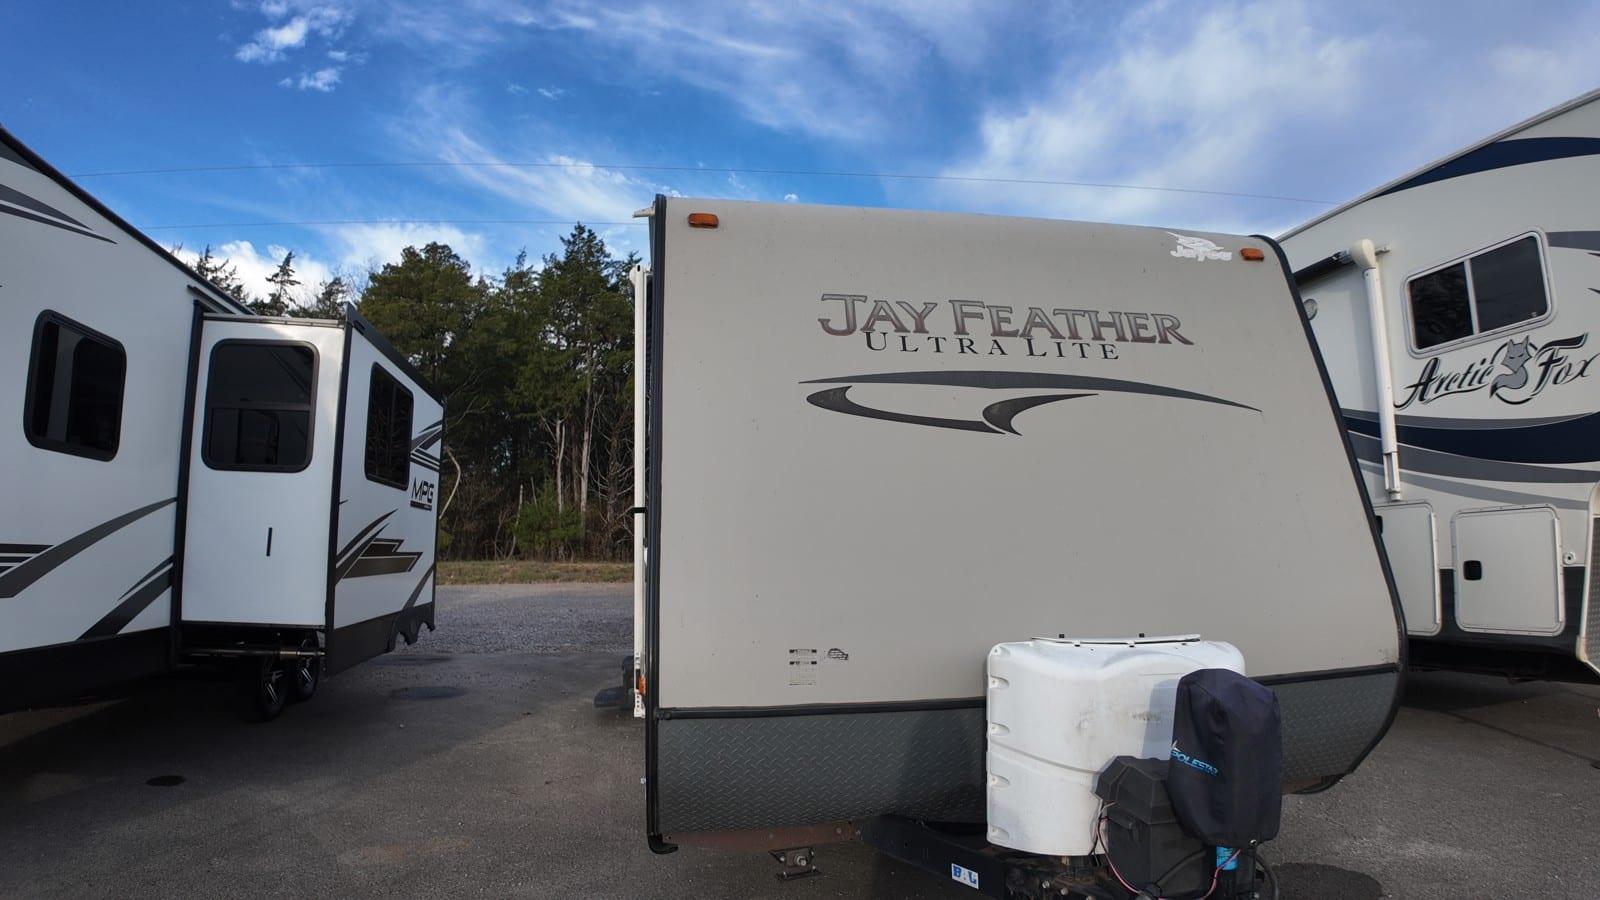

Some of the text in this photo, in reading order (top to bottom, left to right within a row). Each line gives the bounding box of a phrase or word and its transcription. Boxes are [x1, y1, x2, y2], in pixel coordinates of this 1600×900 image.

[818, 293, 1195, 347] JAY FEATHER
[865, 331, 1119, 360] ULTRA LITE
[1393, 332, 1600, 410] Arctic Fox
[411, 476, 435, 504] MPG
